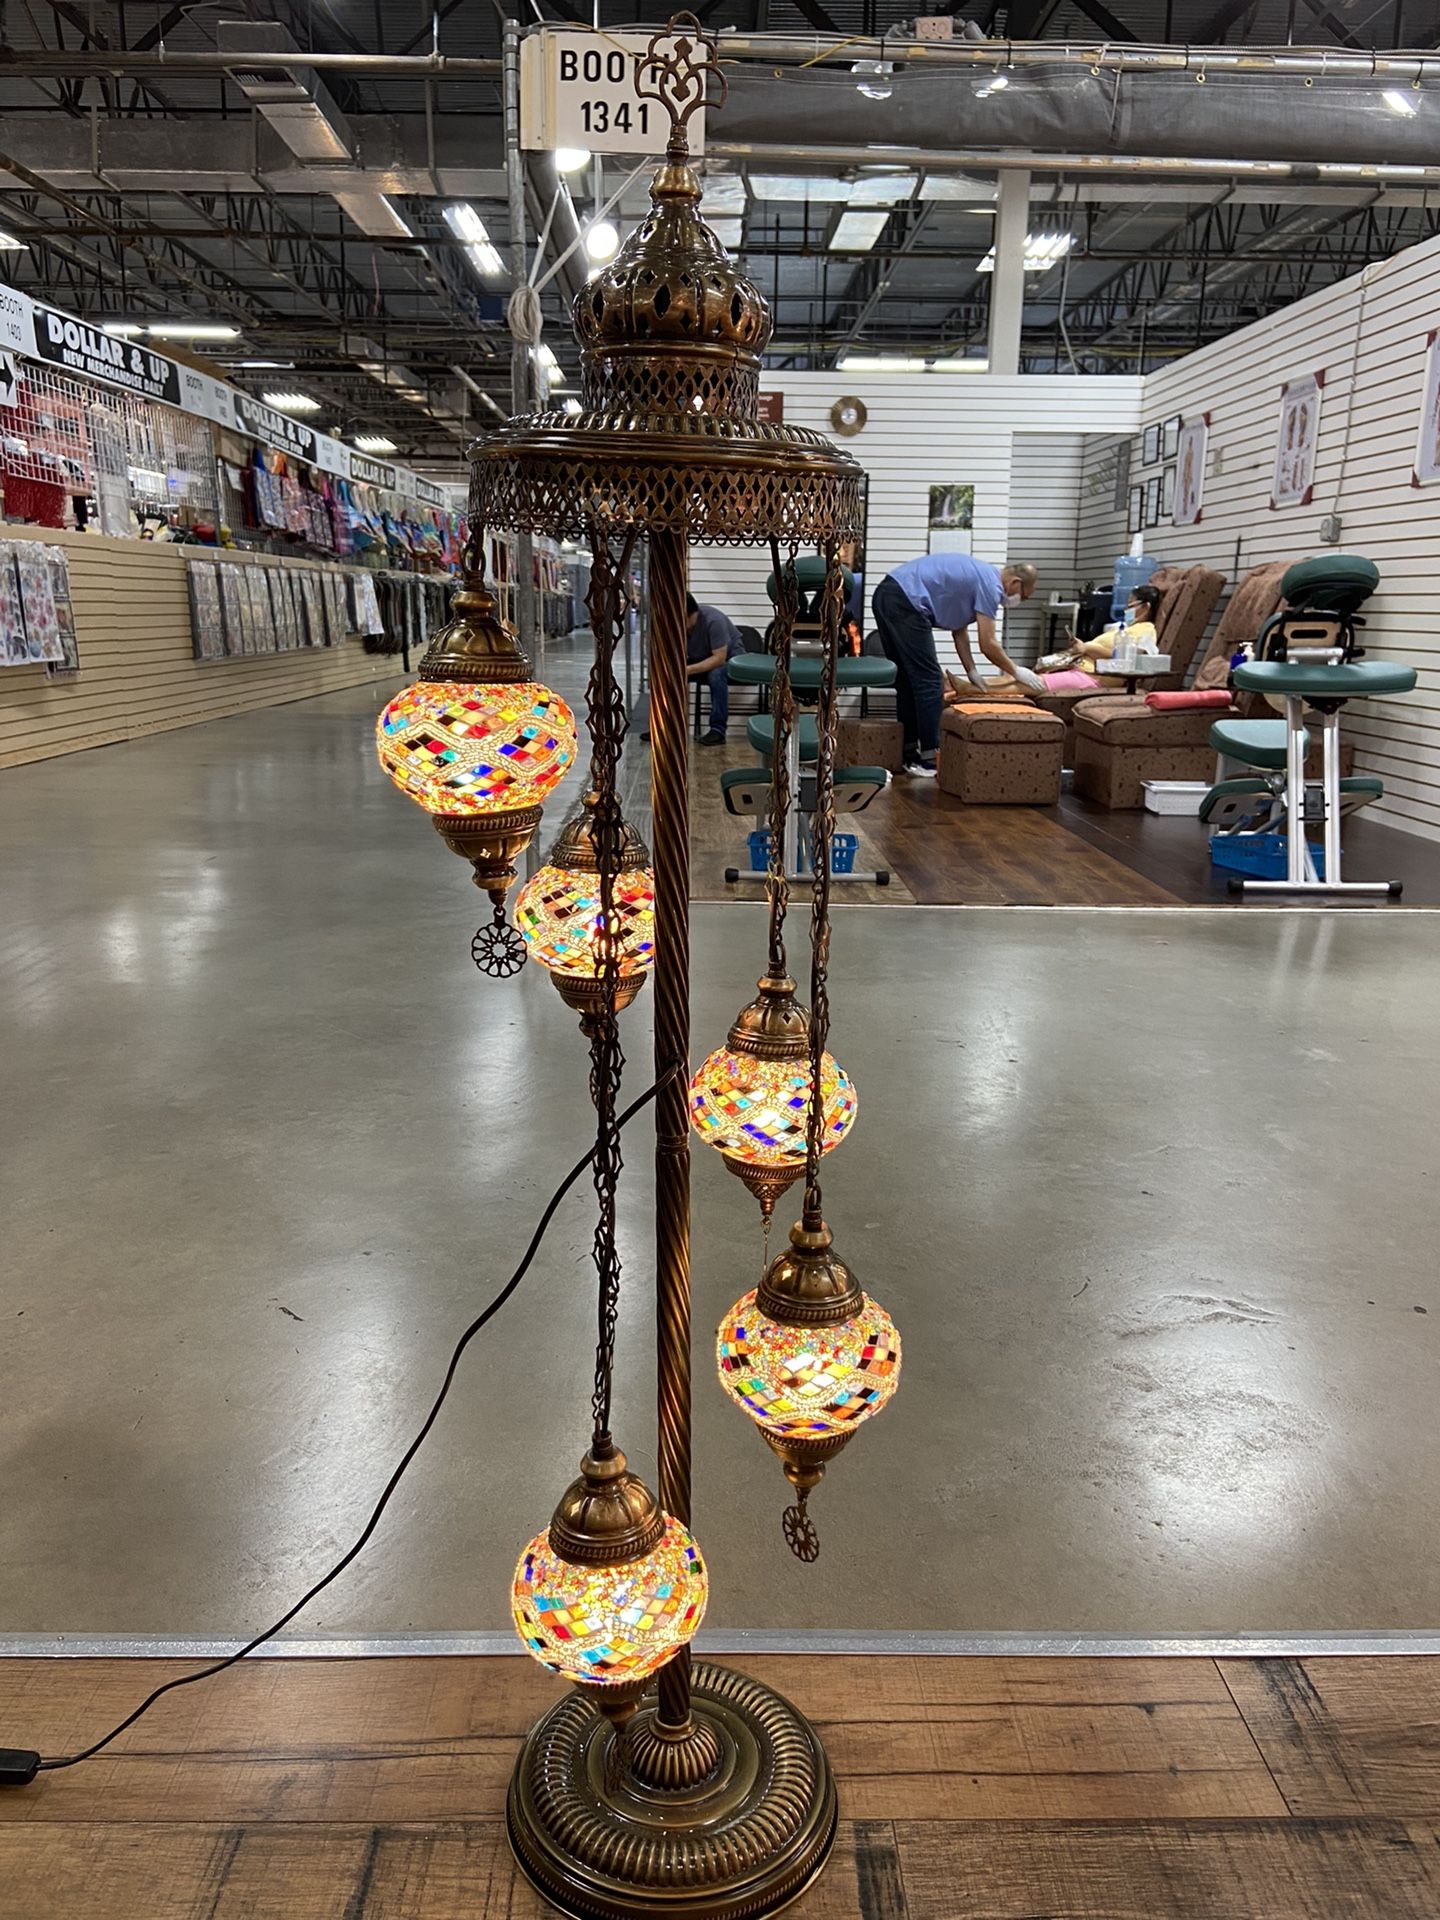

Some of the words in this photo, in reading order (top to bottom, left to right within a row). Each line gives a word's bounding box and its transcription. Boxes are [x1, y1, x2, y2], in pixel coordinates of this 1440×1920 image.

[581, 101, 649, 134] 1341
[47, 313, 125, 368] DOLLAR
[130, 348, 145, 376] &
[149, 355, 169, 384] UP
[62, 348, 85, 368] NEW
[87, 357, 143, 389] MERCHANDISE
[144, 379, 164, 396] DAILY
[241, 398, 285, 436] DOLLAR
[286, 422, 297, 442] &
[298, 426, 312, 448] UP
[351, 457, 380, 484] DOLLAR
